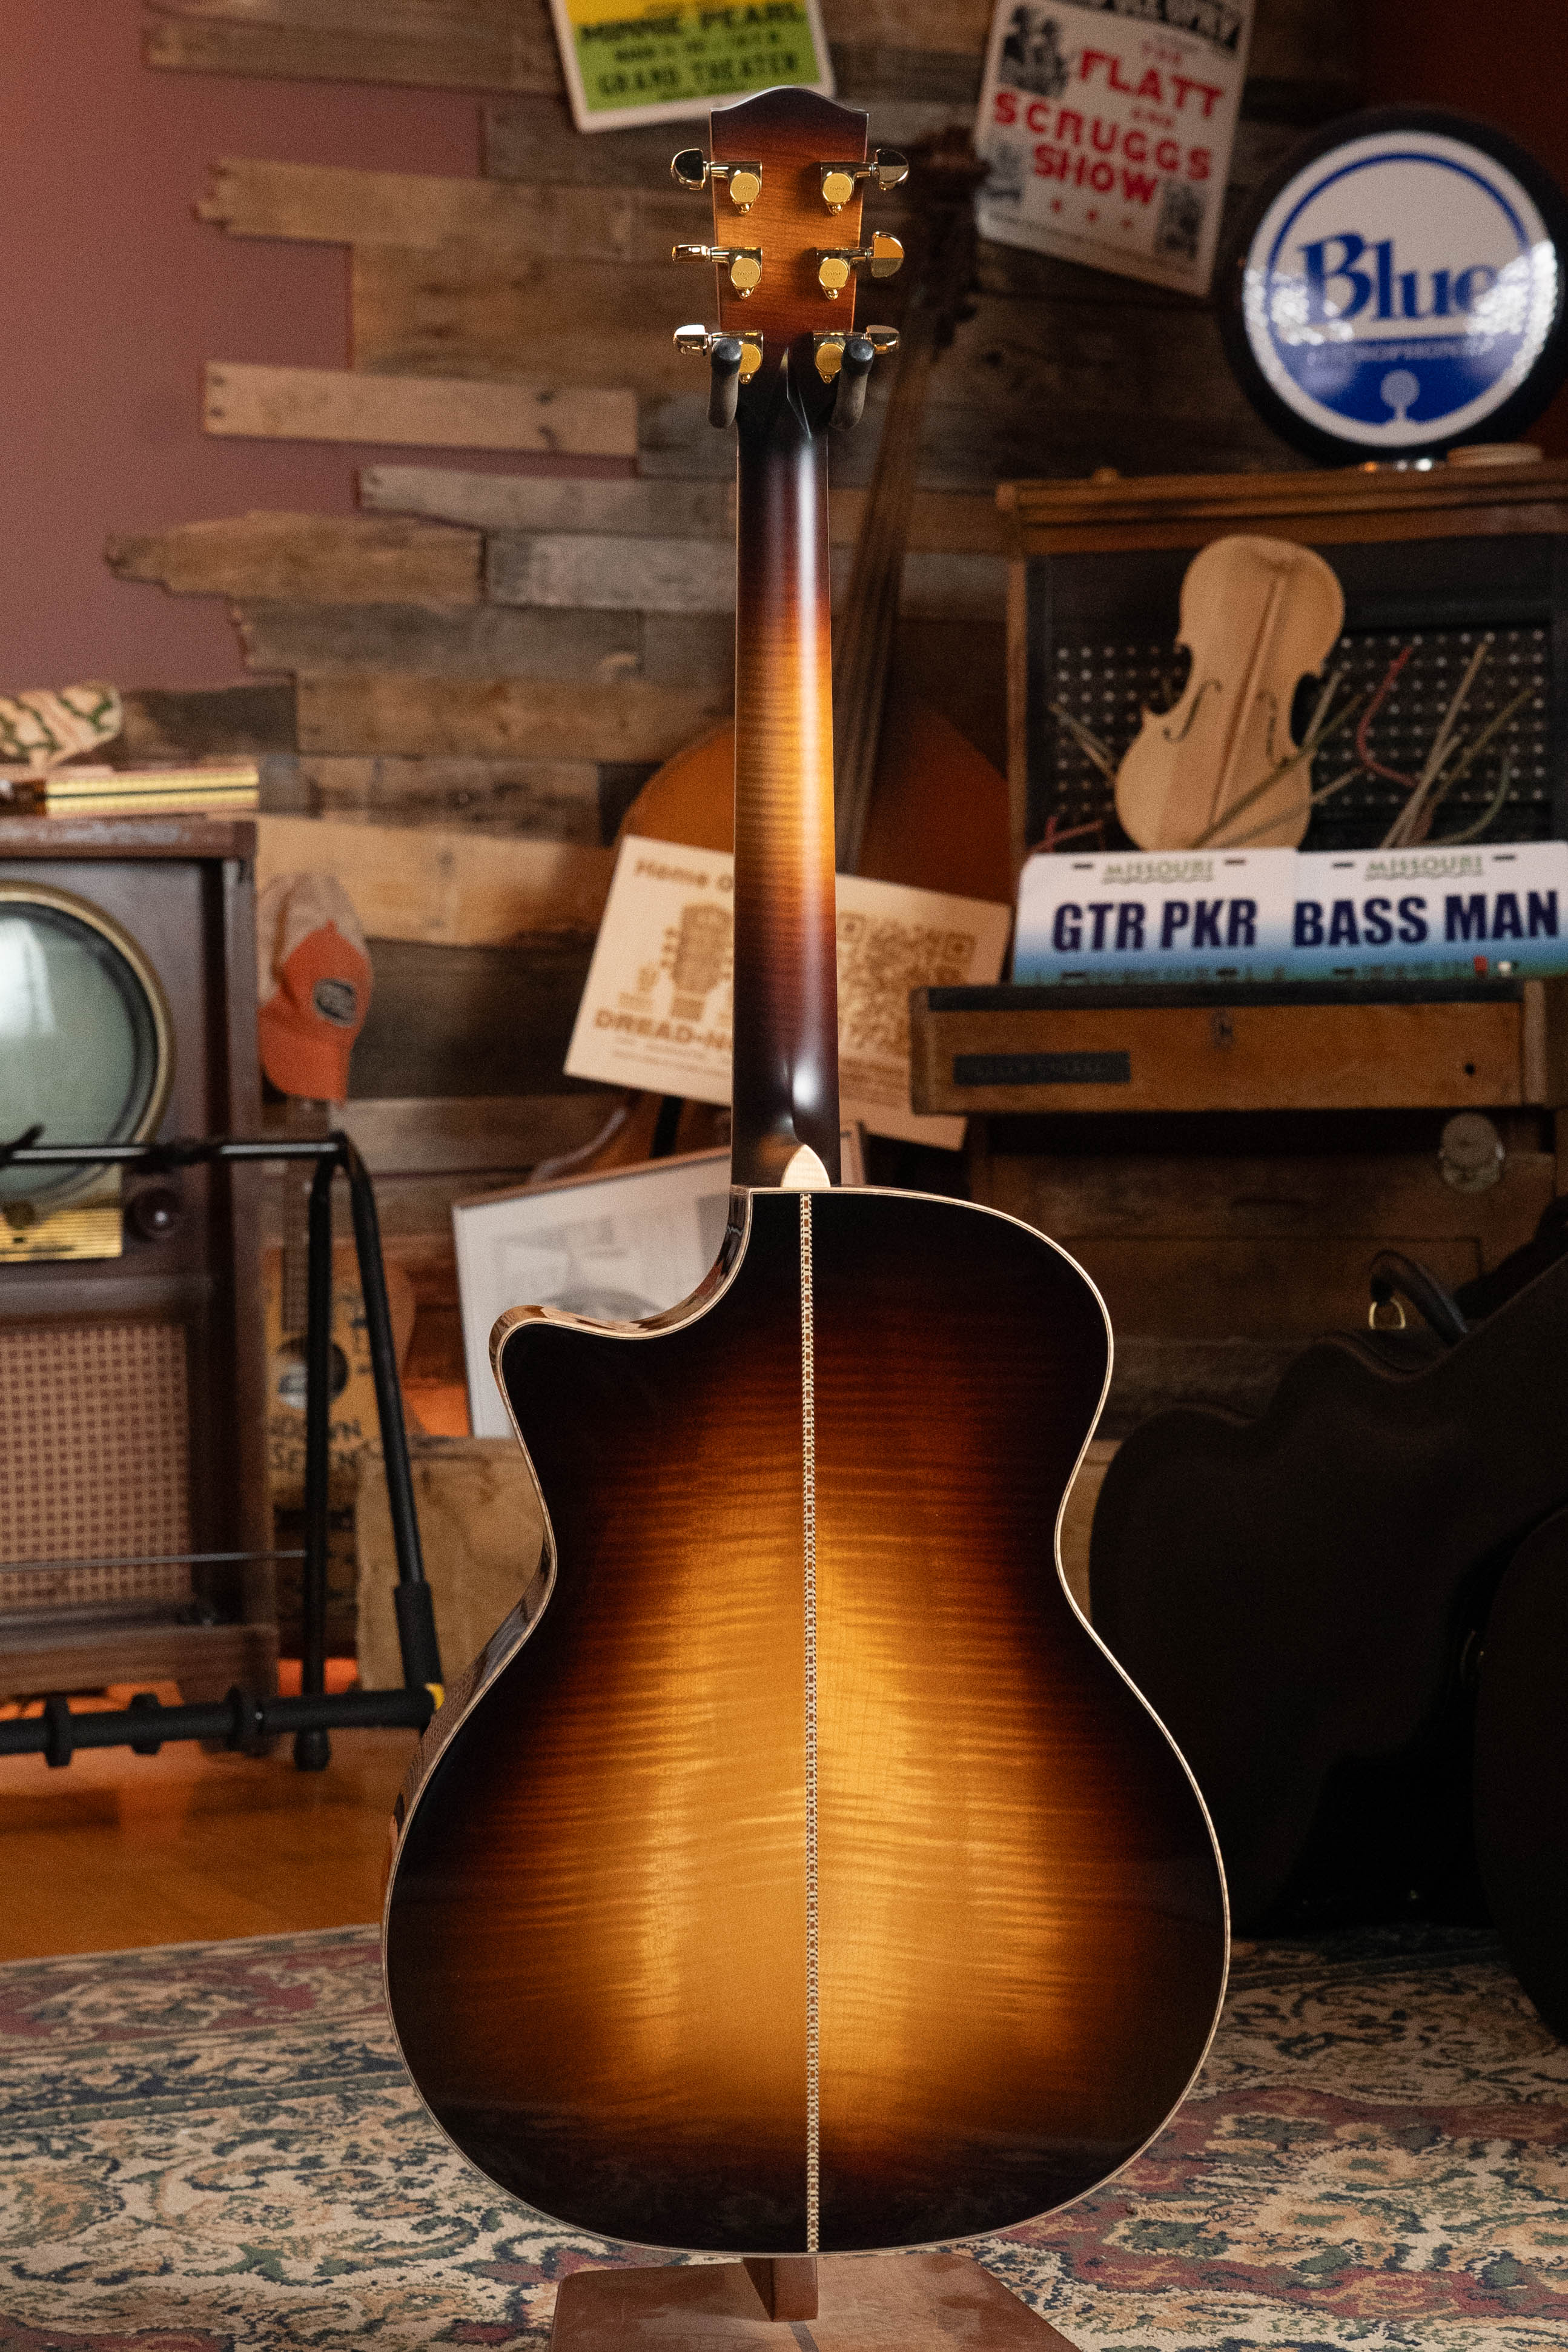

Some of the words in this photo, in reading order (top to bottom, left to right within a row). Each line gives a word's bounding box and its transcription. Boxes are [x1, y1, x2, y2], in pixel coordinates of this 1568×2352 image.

[598, 65, 678, 95] GRAND
[692, 51, 797, 83] THEATER
[1078, 47, 1223, 118] FLATT
[994, 90, 1211, 181] SCRUGGS
[1033, 142, 1158, 205] SHOW
[1297, 231, 1500, 325] Blue
[1105, 858, 1214, 878] MISSOURI
[1367, 855, 1484, 873] MISSOURI
[1052, 901, 1146, 952] GTR
[1159, 897, 1258, 951] PKR
[1292, 895, 1429, 949] BASS
[1444, 890, 1559, 942] MAN
